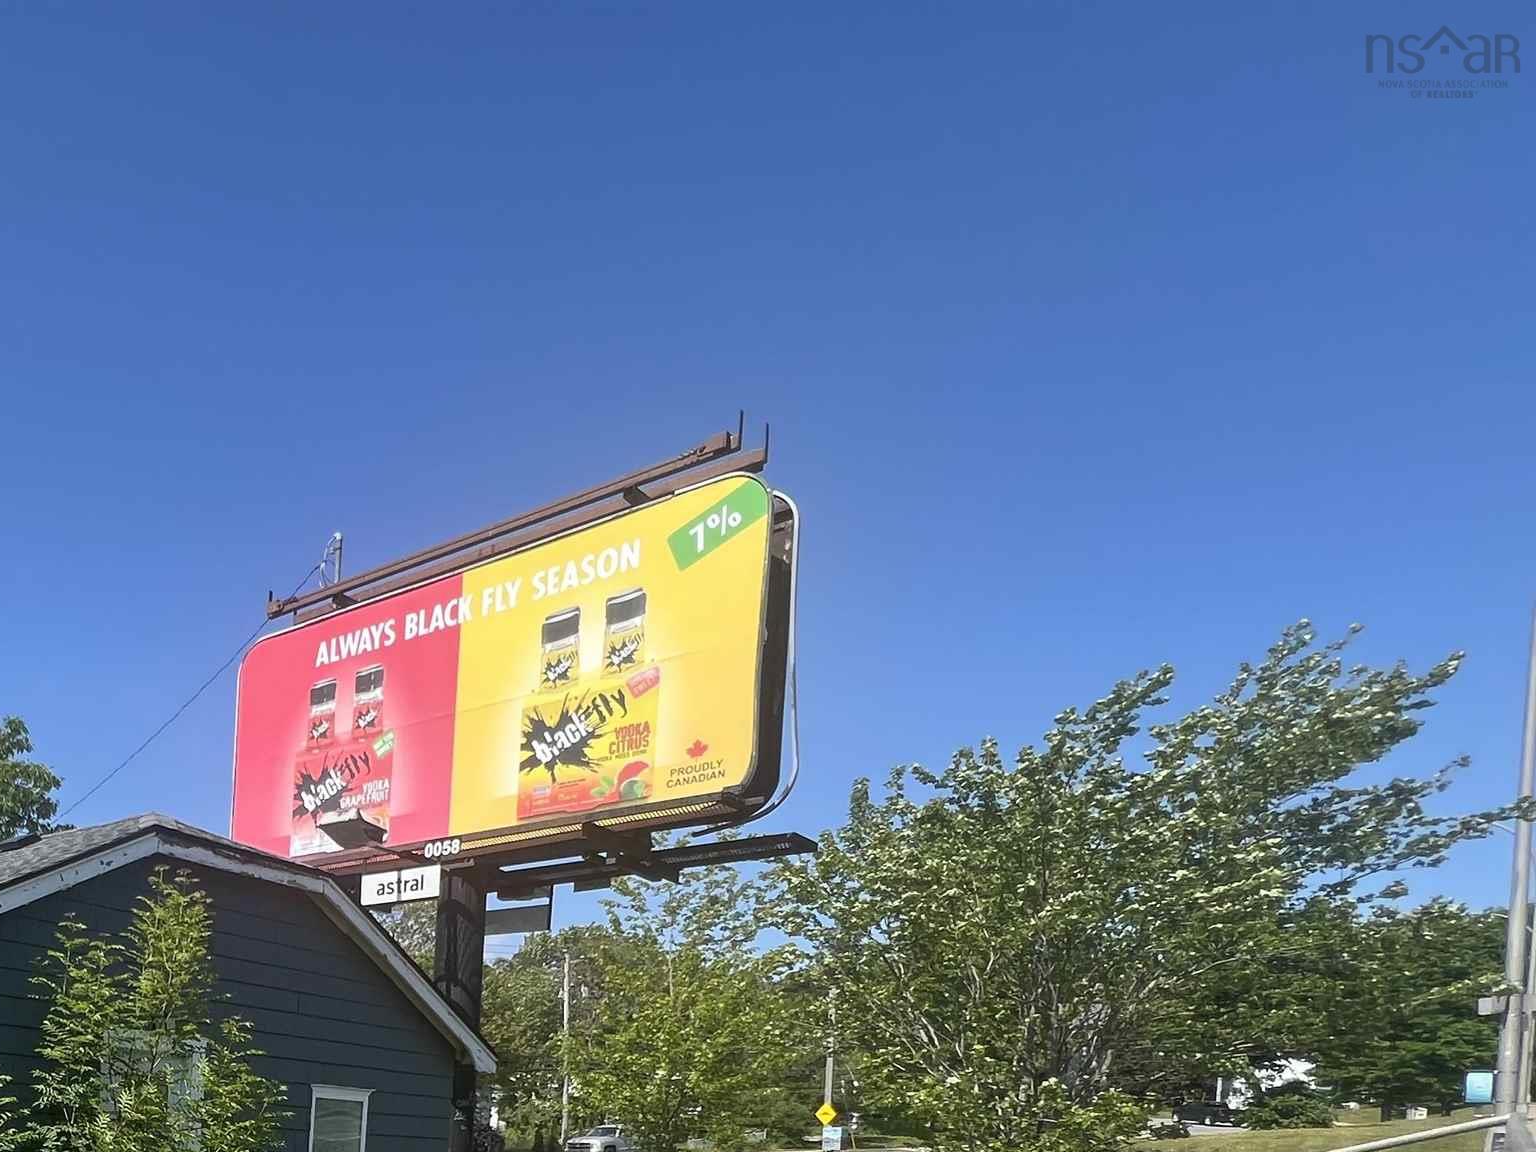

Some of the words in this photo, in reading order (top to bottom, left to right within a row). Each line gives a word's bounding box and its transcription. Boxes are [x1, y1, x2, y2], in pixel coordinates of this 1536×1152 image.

[688, 505, 742, 553] 7%
[315, 619, 396, 668] ALWAYS
[404, 593, 472, 641] BLACK
[482, 576, 522, 617] FLY
[531, 539, 641, 600] SEASON
[531, 712, 595, 762] black
[590, 688, 627, 722] fly
[608, 736, 649, 755] CITRUS
[666, 769, 725, 788] CANADIAN
[670, 759, 723, 778] PROUDLY
[300, 768, 346, 811] black
[339, 790, 389, 809] GRAPEFRUIT
[424, 839, 460, 858] 0058
[377, 874, 424, 896] astral
